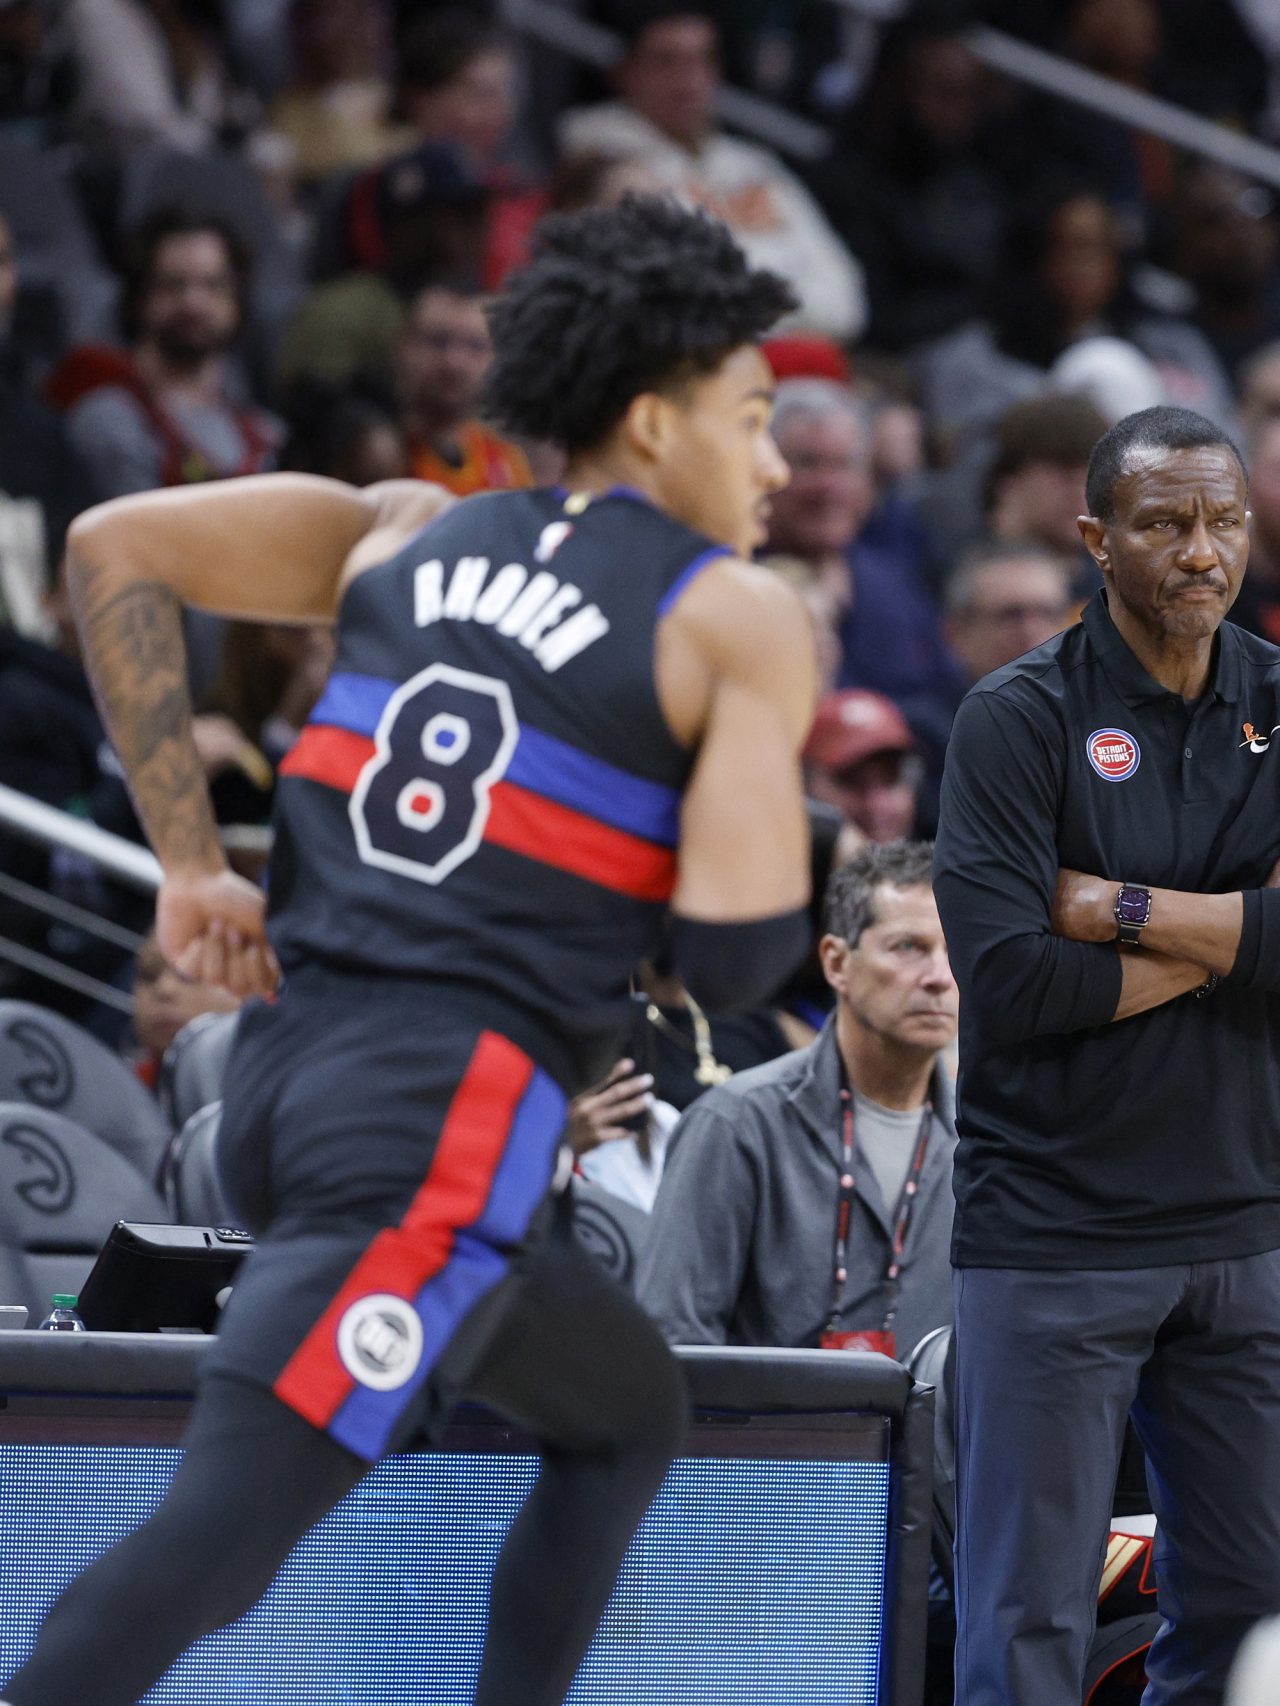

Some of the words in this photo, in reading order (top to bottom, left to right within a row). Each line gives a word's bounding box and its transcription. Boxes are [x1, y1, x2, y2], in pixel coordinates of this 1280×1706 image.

[1095, 743, 1127, 755] DETROIT
[1097, 752, 1130, 763] PISTONS
[349, 662, 519, 884] 8
